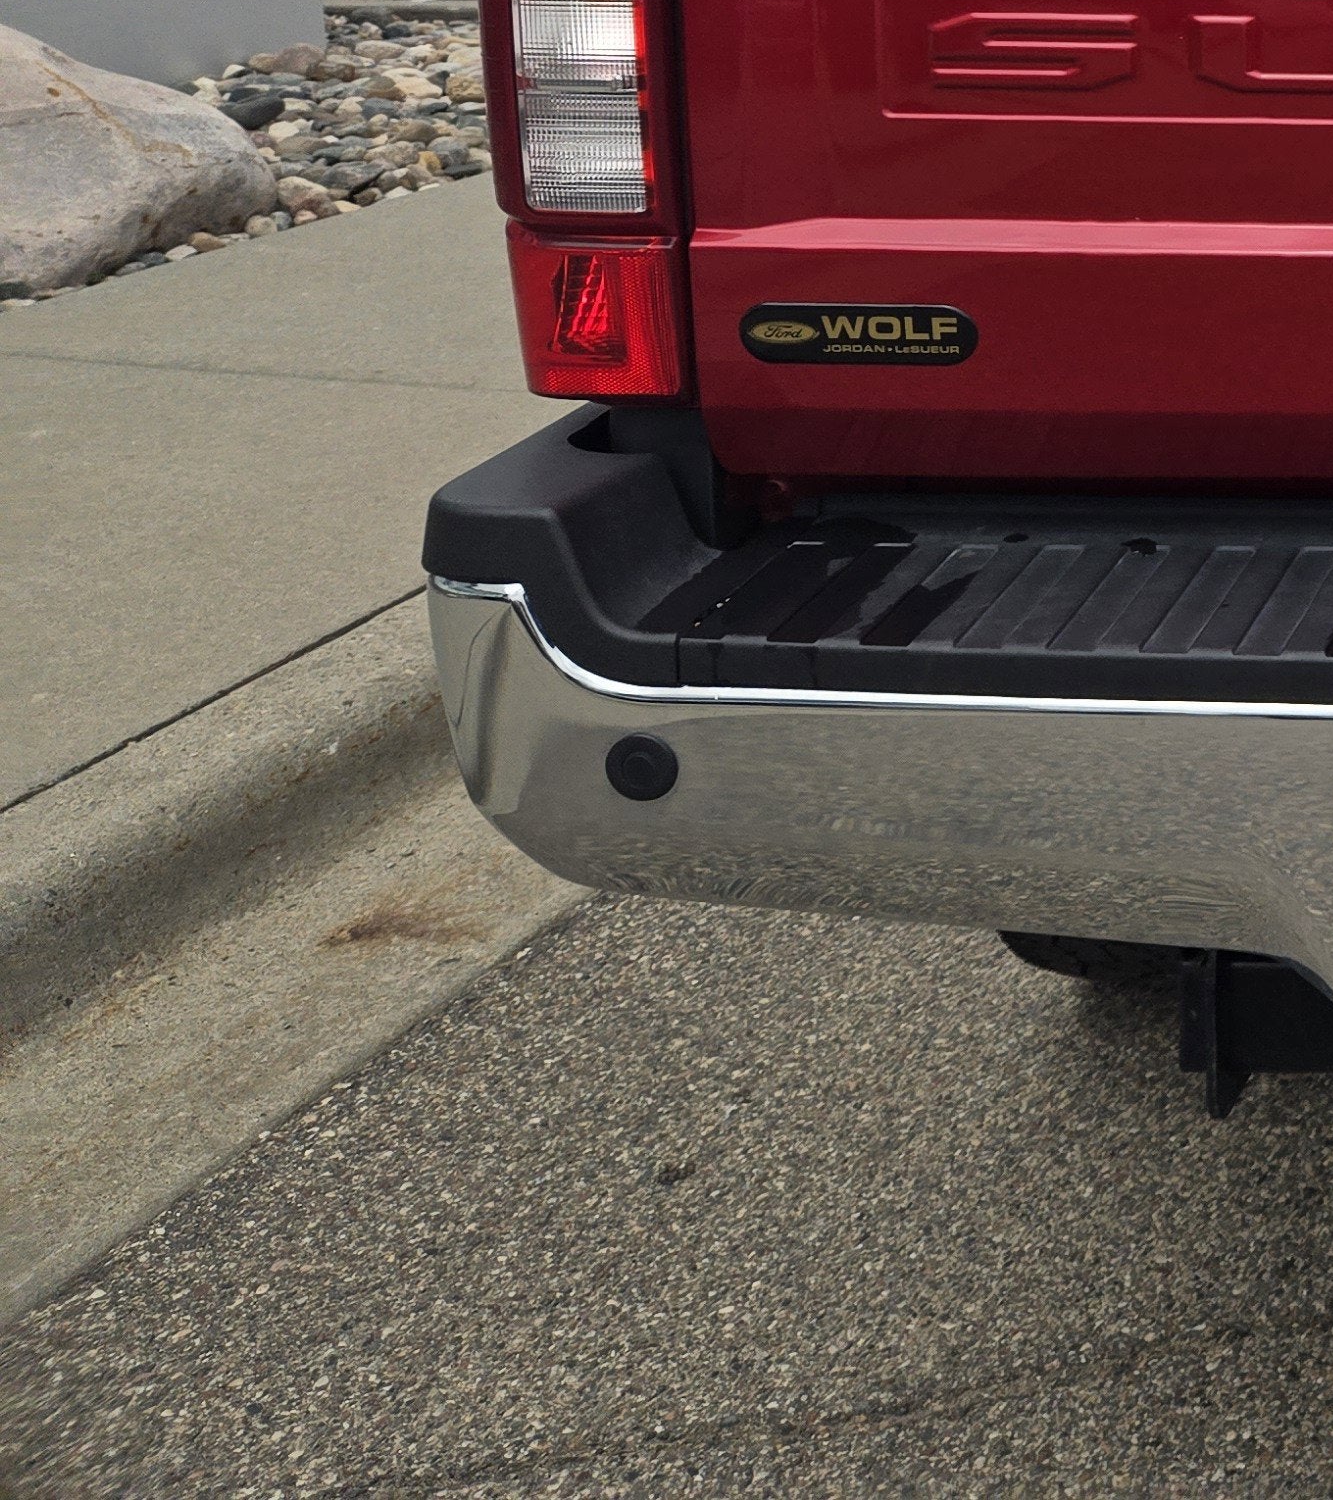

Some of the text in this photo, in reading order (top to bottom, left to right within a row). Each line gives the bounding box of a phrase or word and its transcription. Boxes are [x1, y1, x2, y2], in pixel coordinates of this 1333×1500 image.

[763, 314, 959, 341] Ford WOLF
[822, 344, 886, 354] JORDAN
